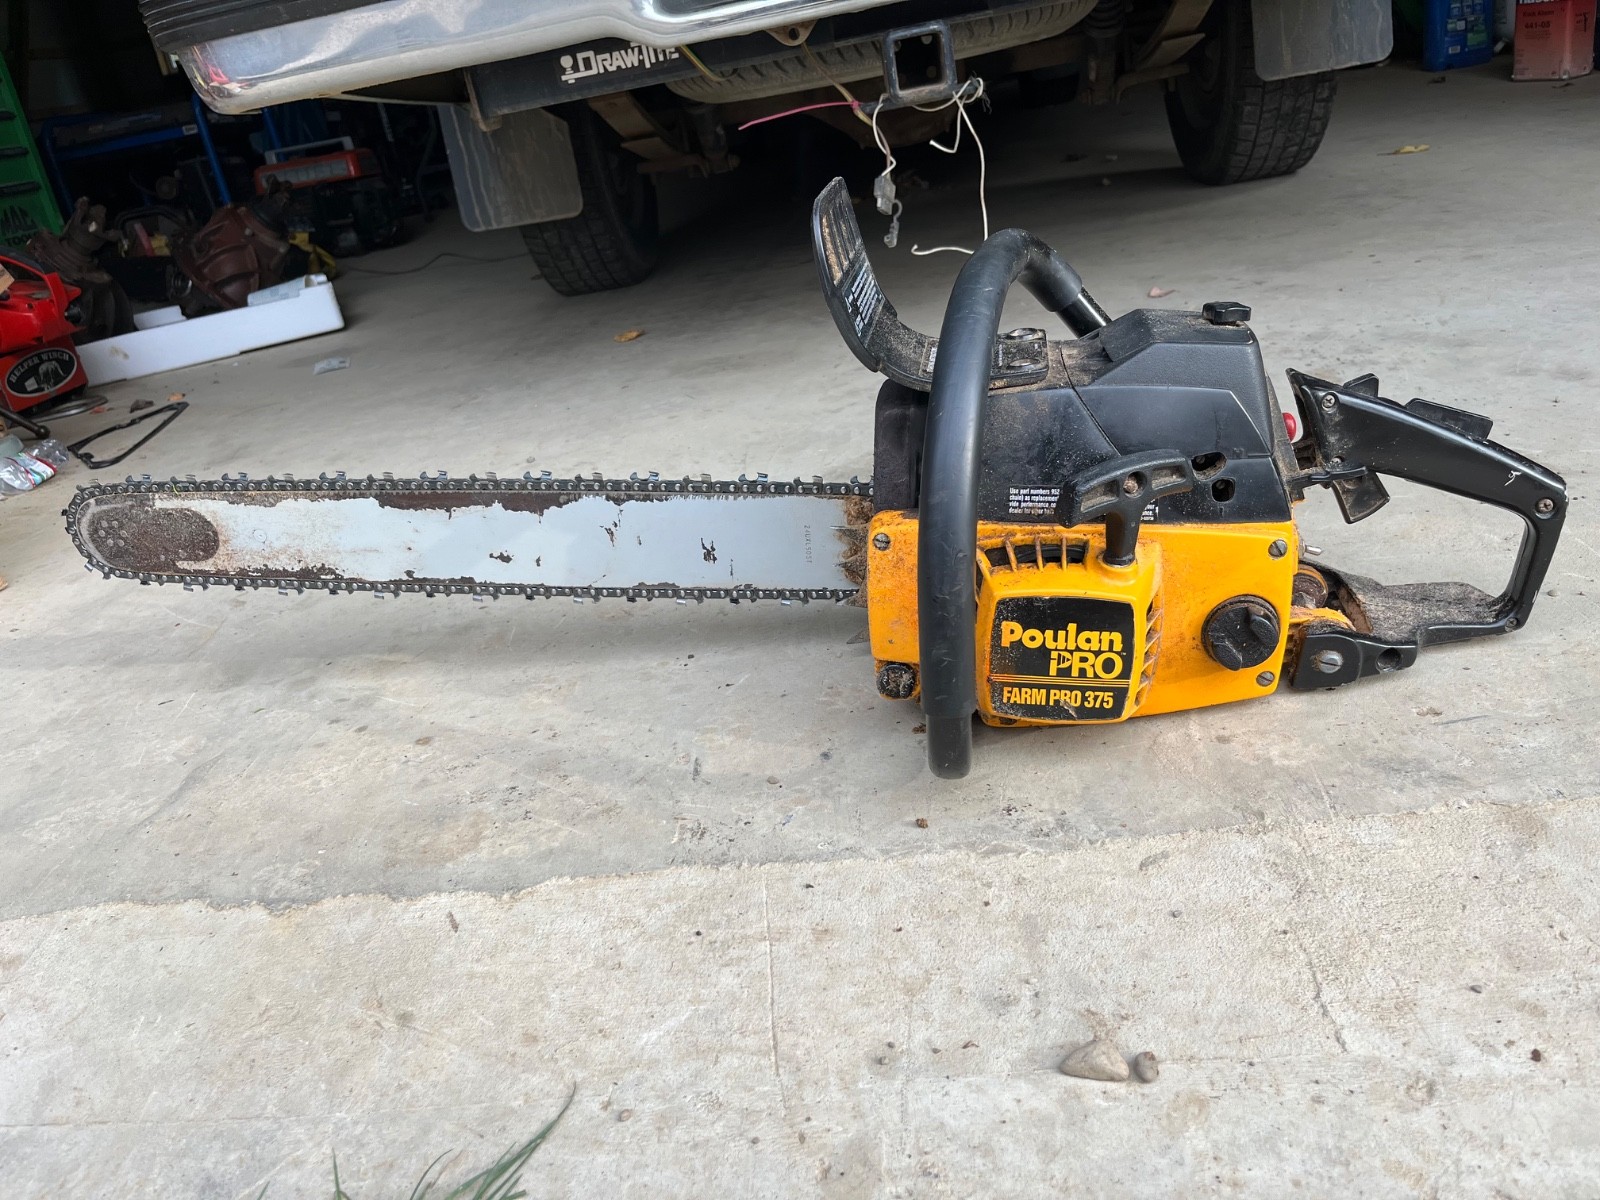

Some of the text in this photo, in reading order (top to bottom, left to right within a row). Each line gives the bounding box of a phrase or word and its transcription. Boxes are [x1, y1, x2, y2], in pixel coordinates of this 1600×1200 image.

[9, 351, 70, 383] HELPER WINCH
[1009, 487, 1019, 495] Use
[1020, 487, 1030, 495] part
[1001, 620, 1123, 651] Poulan
[1049, 651, 1123, 680] PRO
[1003, 686, 1114, 709] FARM PRO 375
